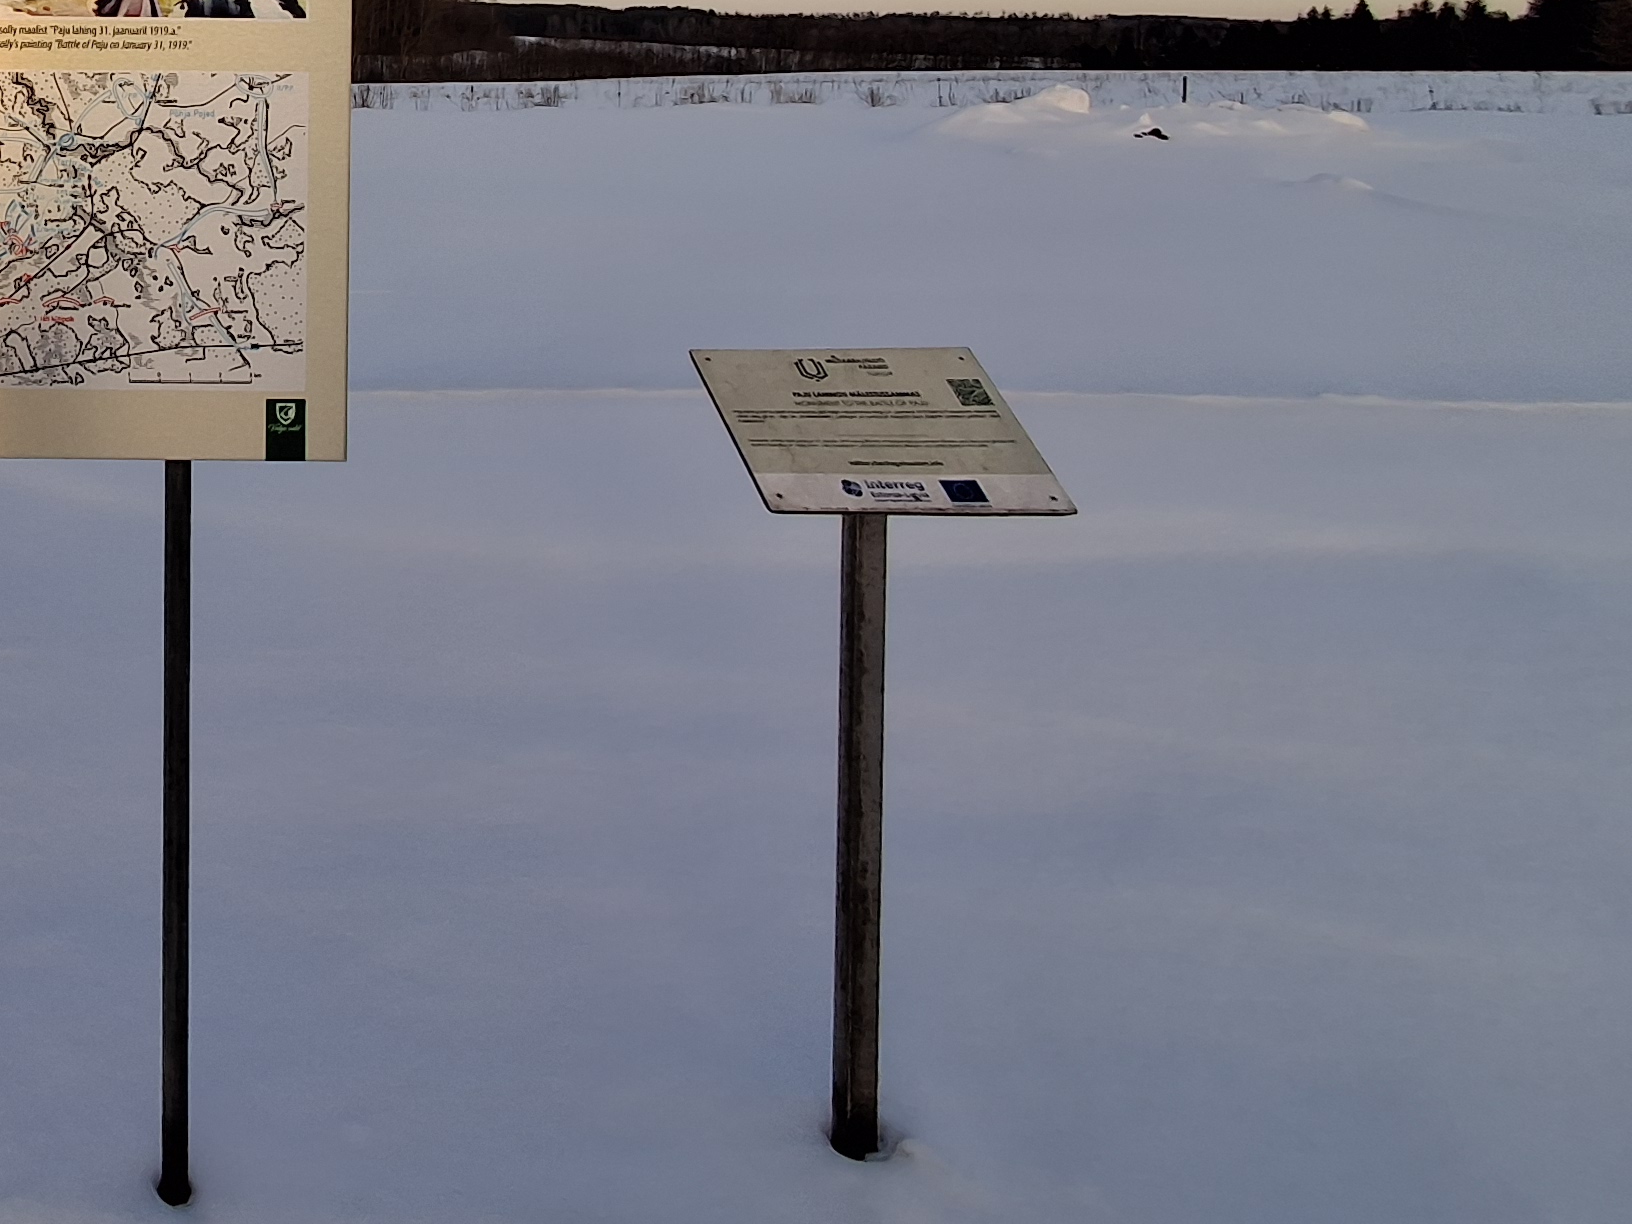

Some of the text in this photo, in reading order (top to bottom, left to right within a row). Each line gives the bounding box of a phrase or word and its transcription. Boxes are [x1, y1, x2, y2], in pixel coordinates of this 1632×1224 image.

[72, 26, 97, 37] lahing
[99, 26, 111, 36] 31.
[82, 39, 91, 49] of
[91, 40, 108, 51] Paju
[121, 40, 152, 51] January
[153, 40, 166, 51] 31,
[864, 479, 925, 491] Interreg
